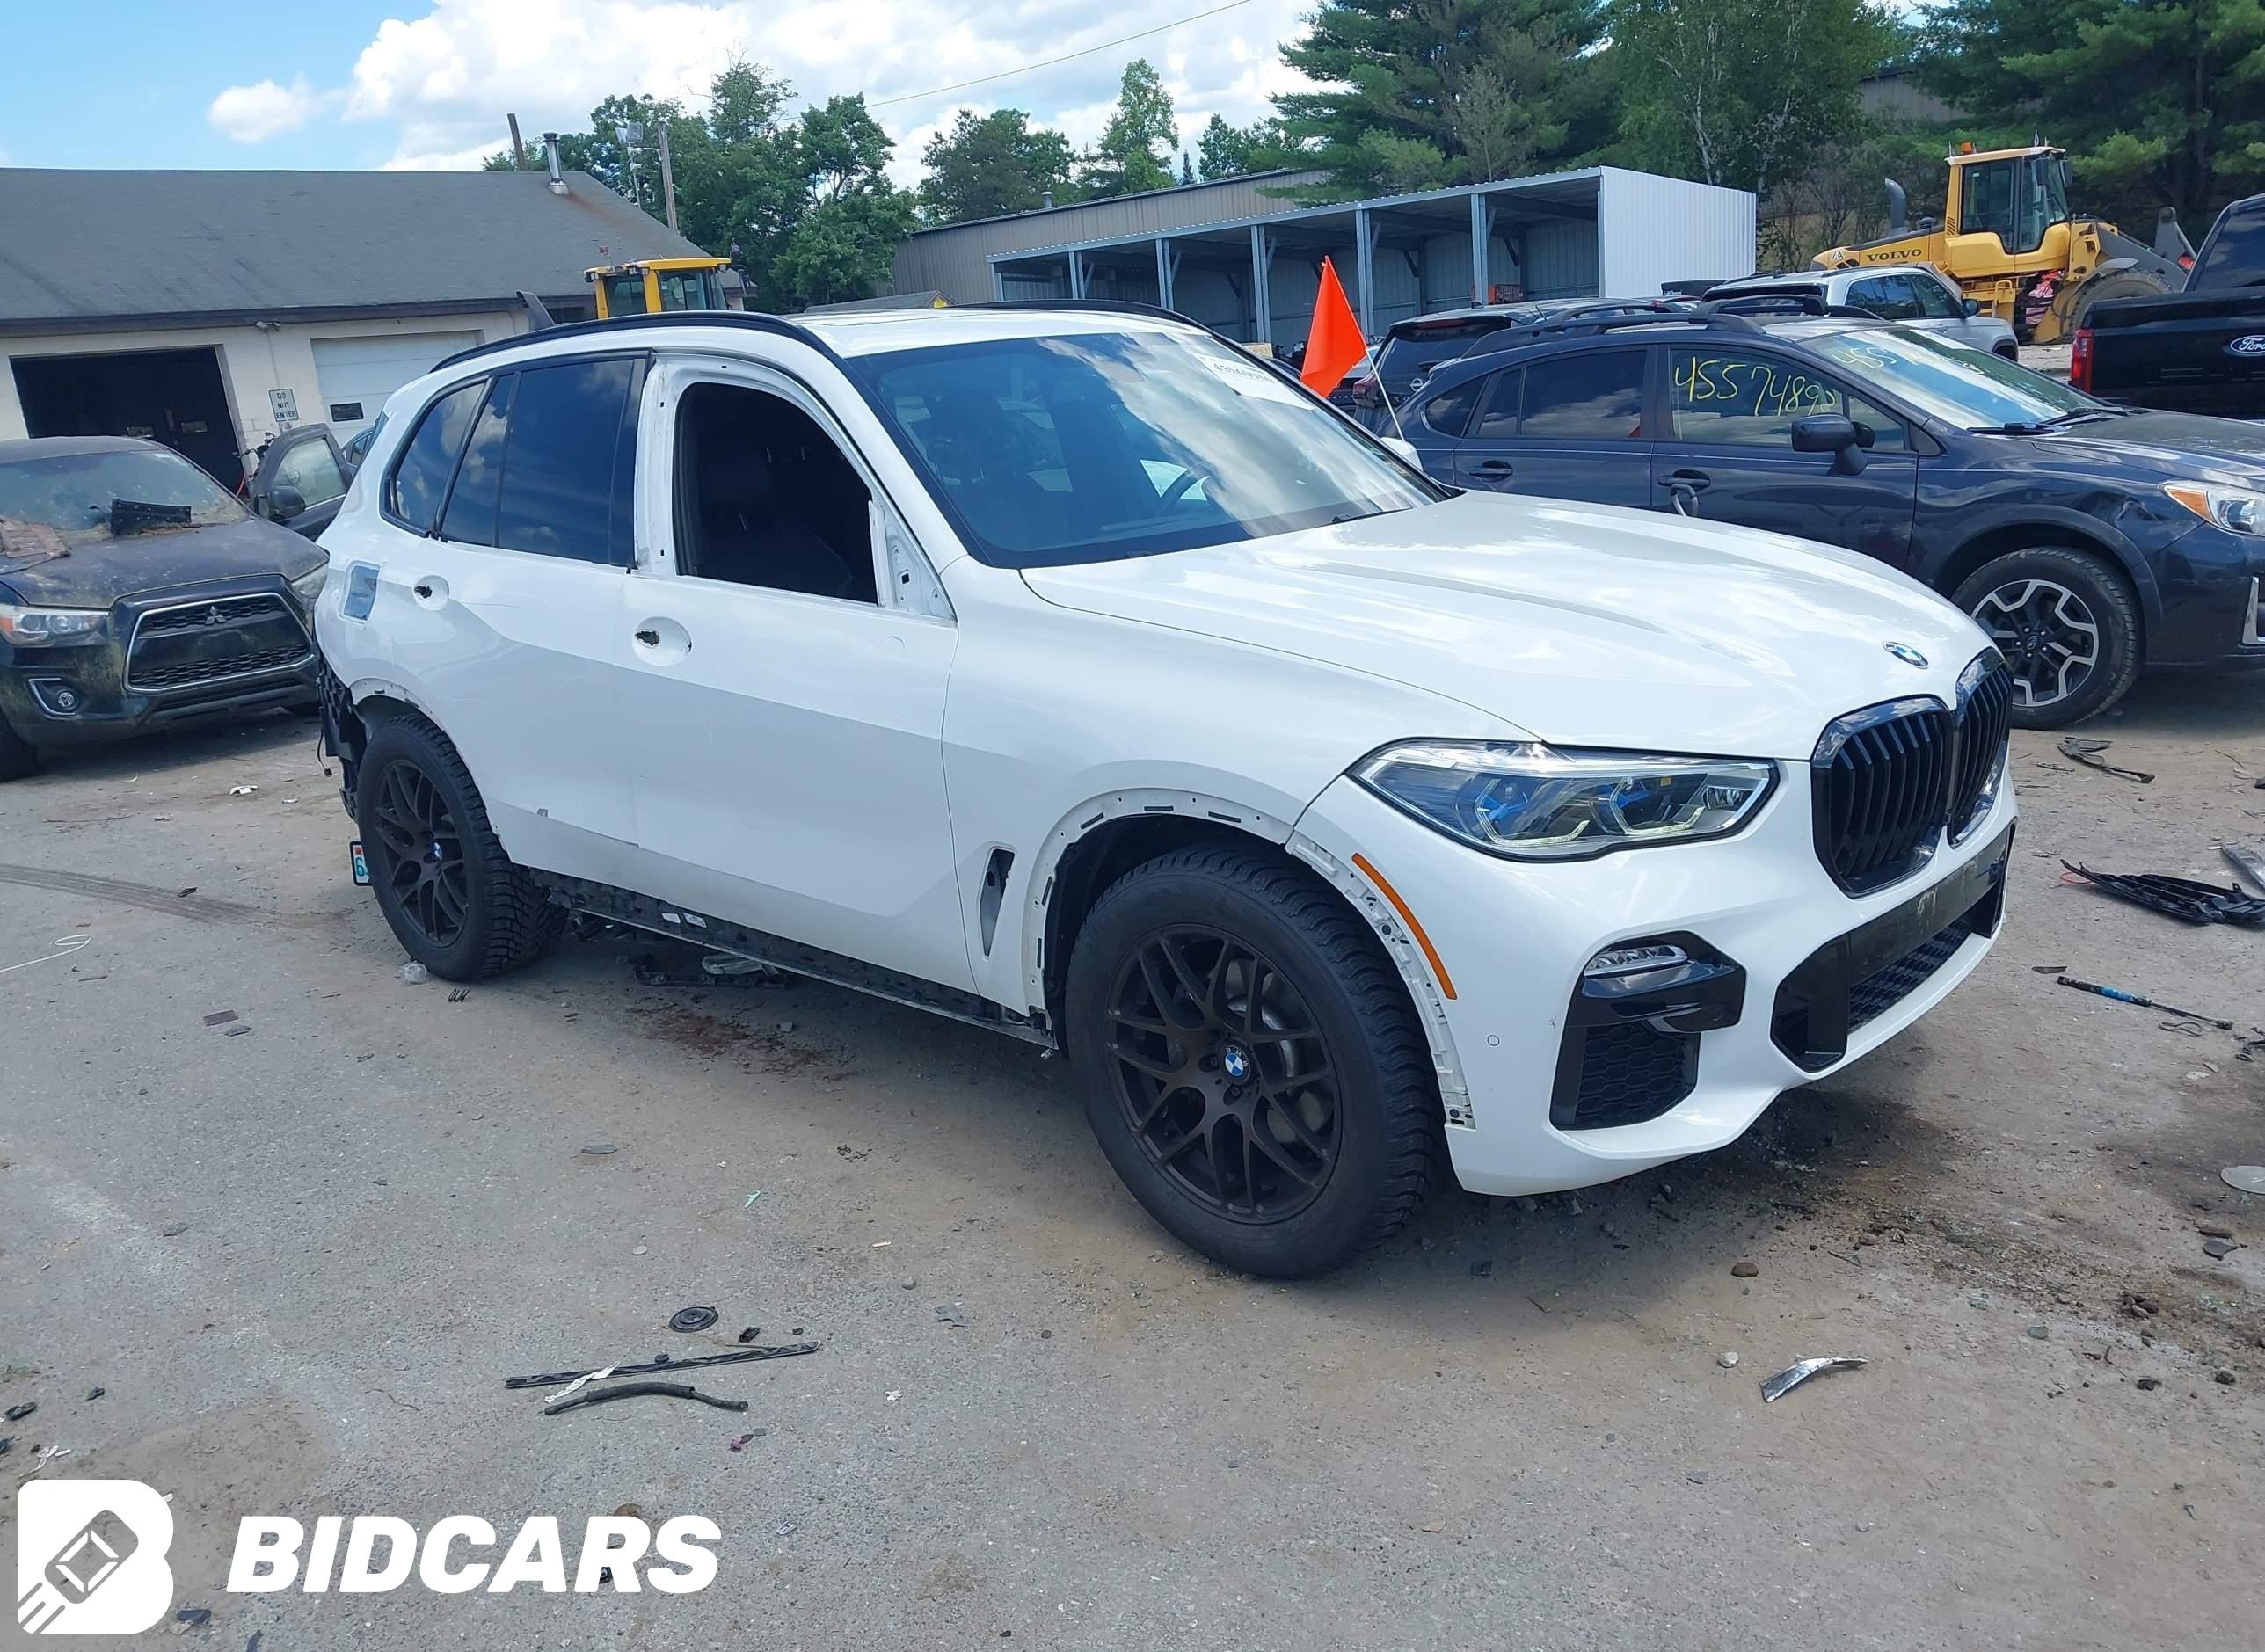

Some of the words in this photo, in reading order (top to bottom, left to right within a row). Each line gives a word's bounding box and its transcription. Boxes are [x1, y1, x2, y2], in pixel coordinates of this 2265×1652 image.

[1867, 249, 1922, 262] VOLVO
[275, 410, 296, 419] ENTER
[355, 856, 367, 877] 6
